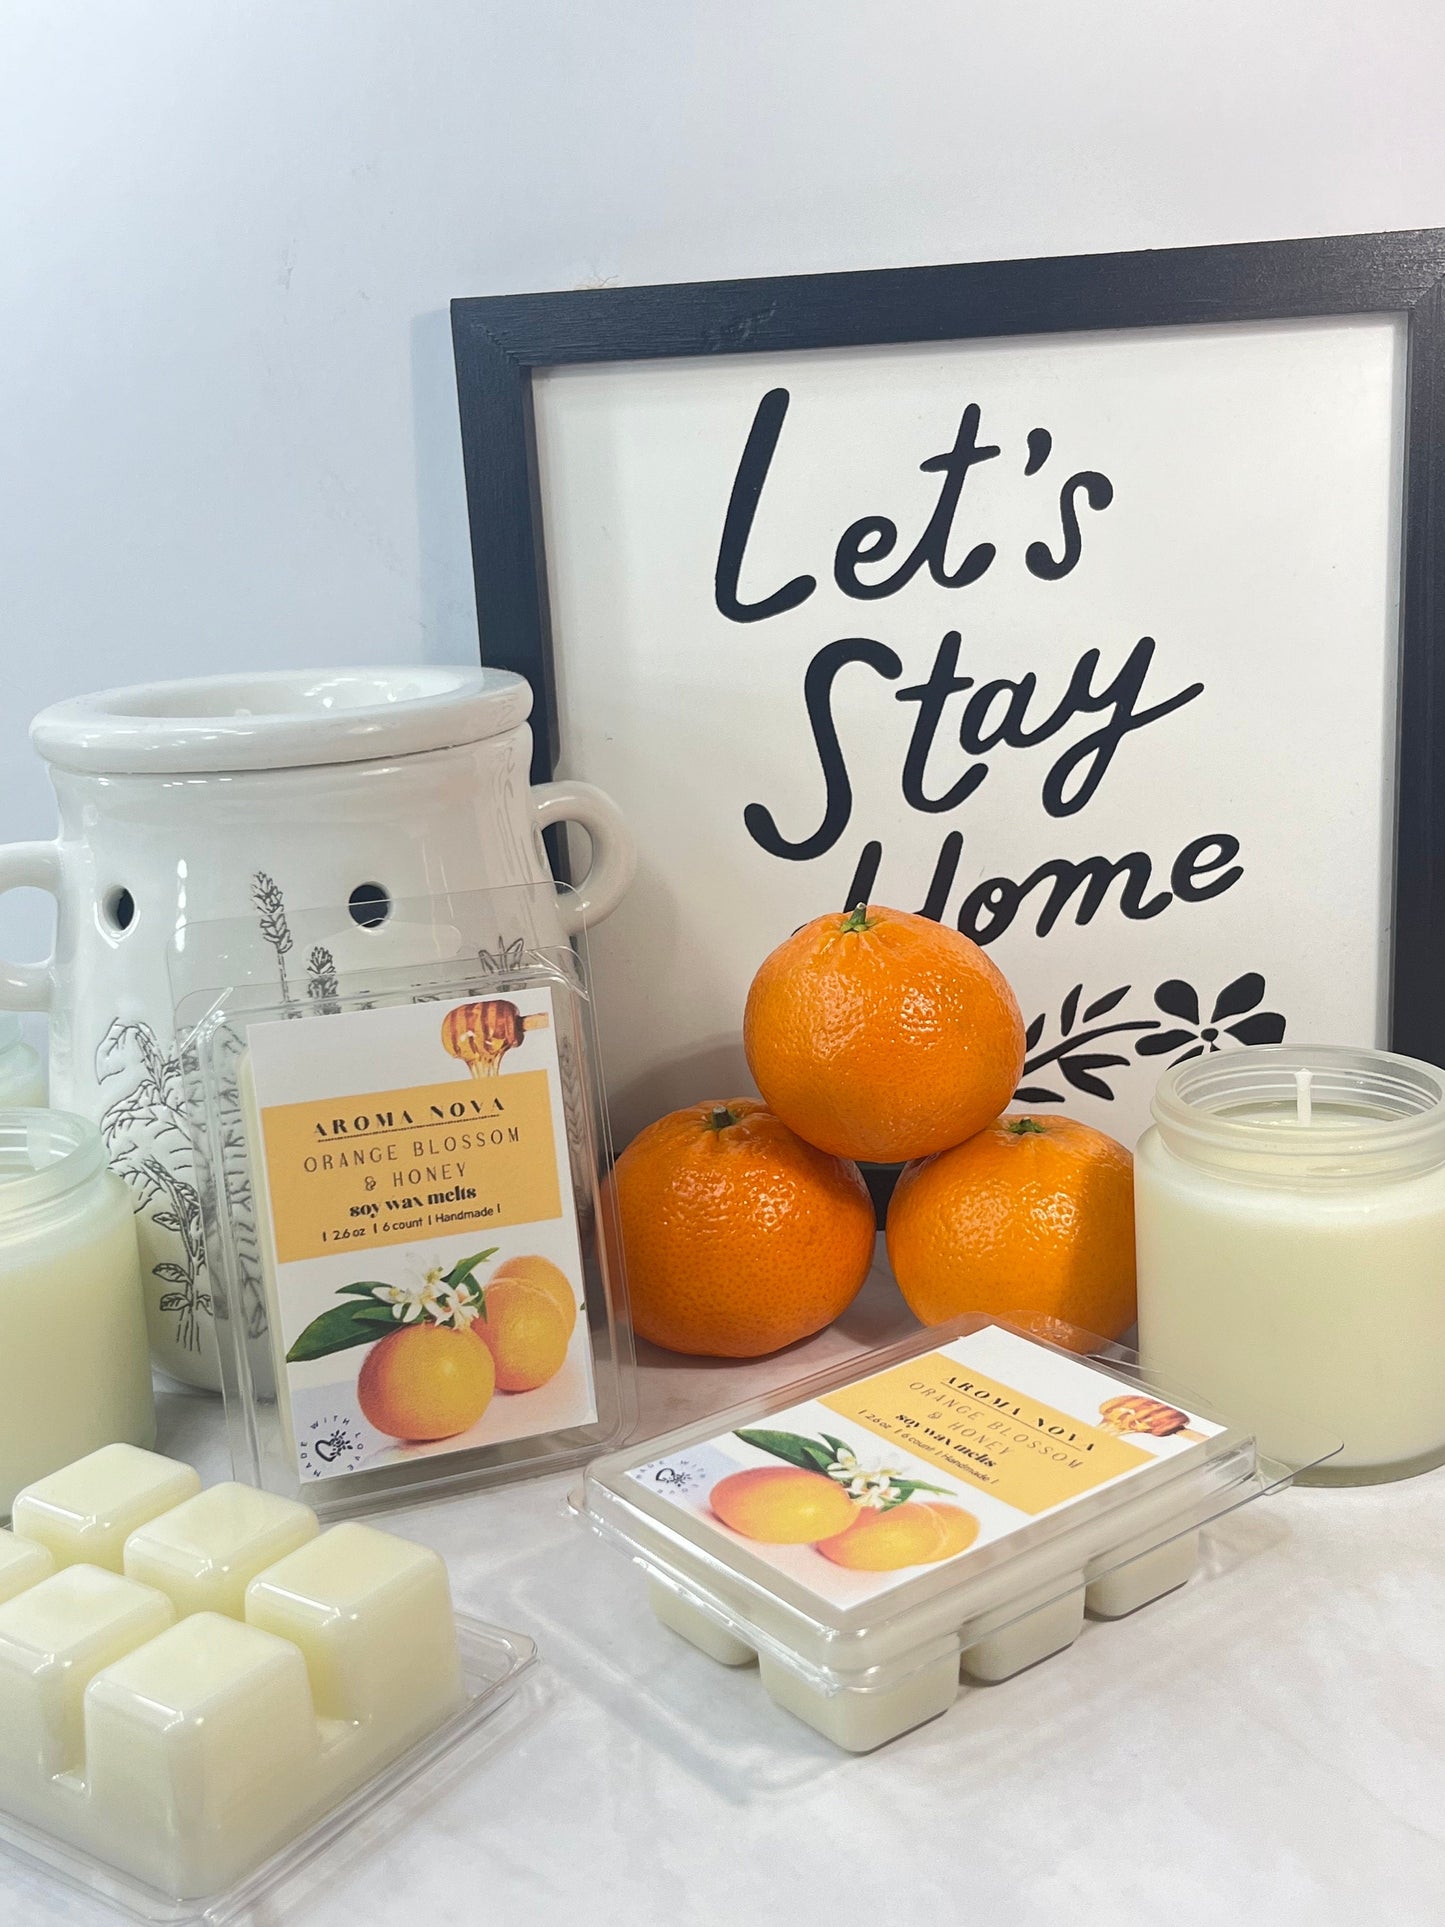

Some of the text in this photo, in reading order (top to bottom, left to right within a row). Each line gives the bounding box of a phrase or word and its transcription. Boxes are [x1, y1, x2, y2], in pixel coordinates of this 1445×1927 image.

[714, 387, 1114, 623] Let's
[743, 630, 1205, 861] Stay
[315, 1097, 505, 1137] AROMA NOVA
[303, 1126, 519, 1173] ORANGE BLOSSOM
[364, 1161, 466, 1191] & HONEY
[349, 1184, 477, 1219] soy wax melts
[435, 1206, 494, 1223] Handmade
[943, 1376, 1021, 1416] AROMA
[908, 1381, 1084, 1468] ORANGE BLOSSOM
[947, 1421, 1015, 1456] HONEY
